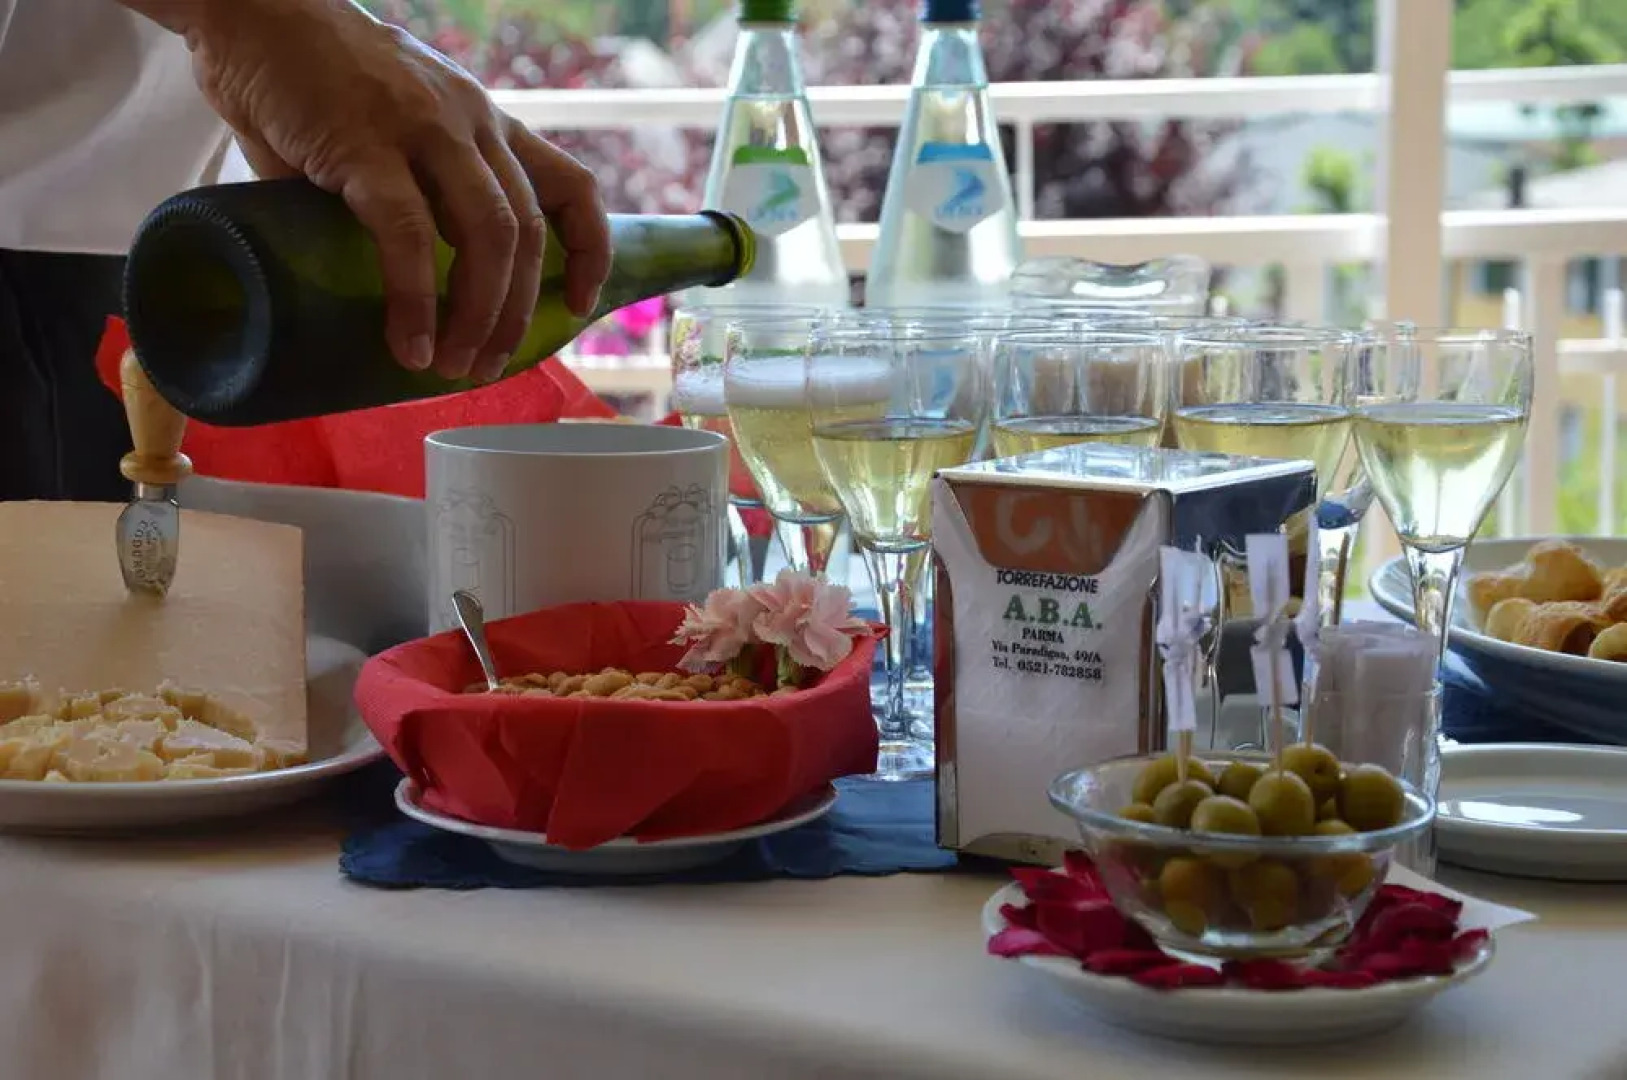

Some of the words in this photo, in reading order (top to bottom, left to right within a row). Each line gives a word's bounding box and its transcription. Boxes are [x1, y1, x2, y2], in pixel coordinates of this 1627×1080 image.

[996, 570, 1098, 594] TORREFAZIONE
[1002, 594, 1103, 630] A.B.A.
[1022, 628, 1064, 644] PARMA
[992, 640, 1008, 652] Via
[1074, 650, 1101, 663] 49/A
[992, 657, 1012, 670] Tel.
